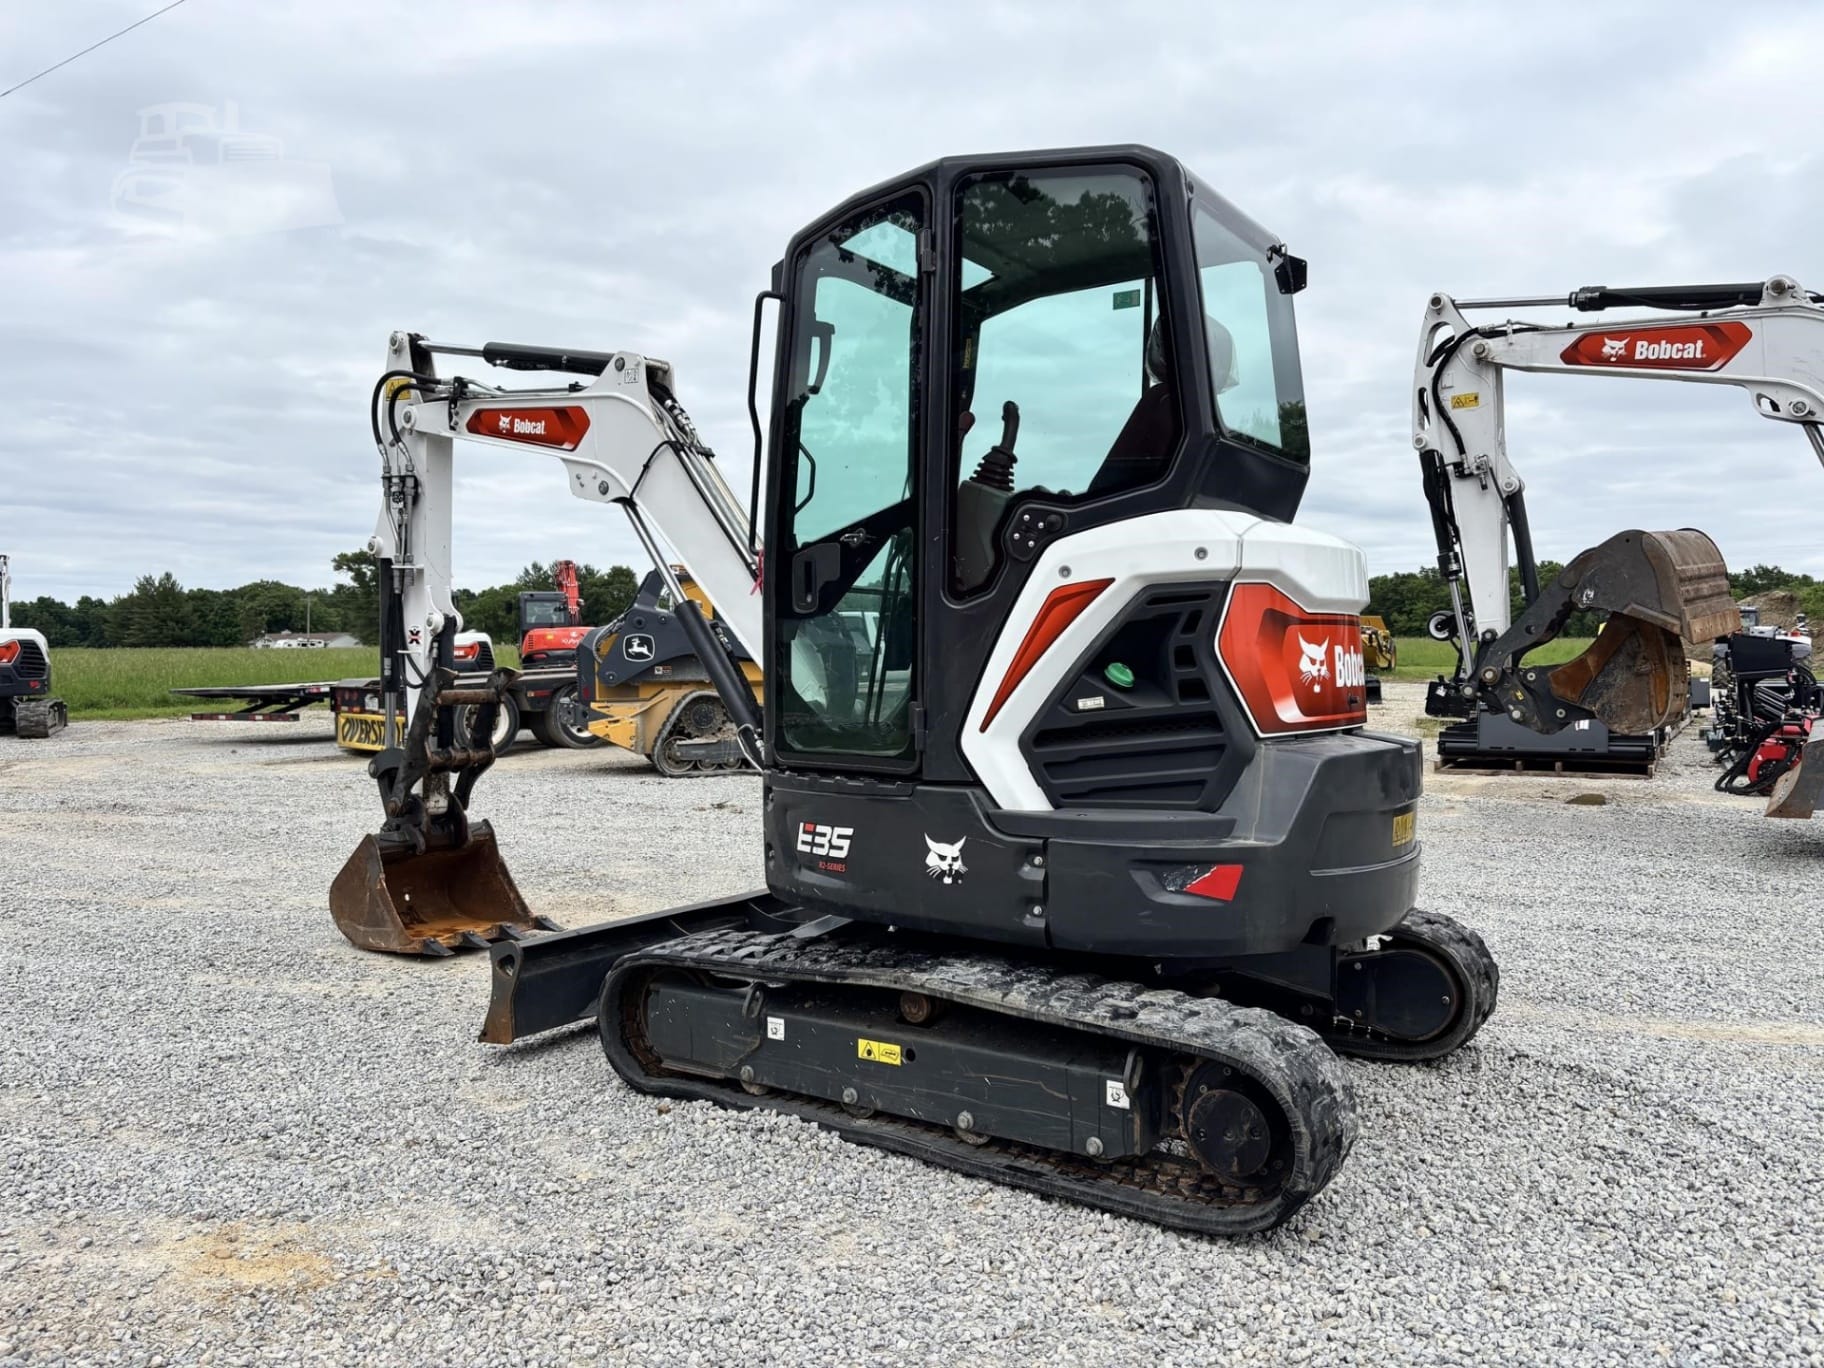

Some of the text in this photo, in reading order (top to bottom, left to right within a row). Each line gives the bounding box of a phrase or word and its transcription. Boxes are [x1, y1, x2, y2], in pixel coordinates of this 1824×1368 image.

[1634, 339, 1704, 360] Bobcat
[514, 418, 546, 436] Bobcat
[1334, 645, 1365, 688] Bobc
[797, 822, 854, 858] E35
